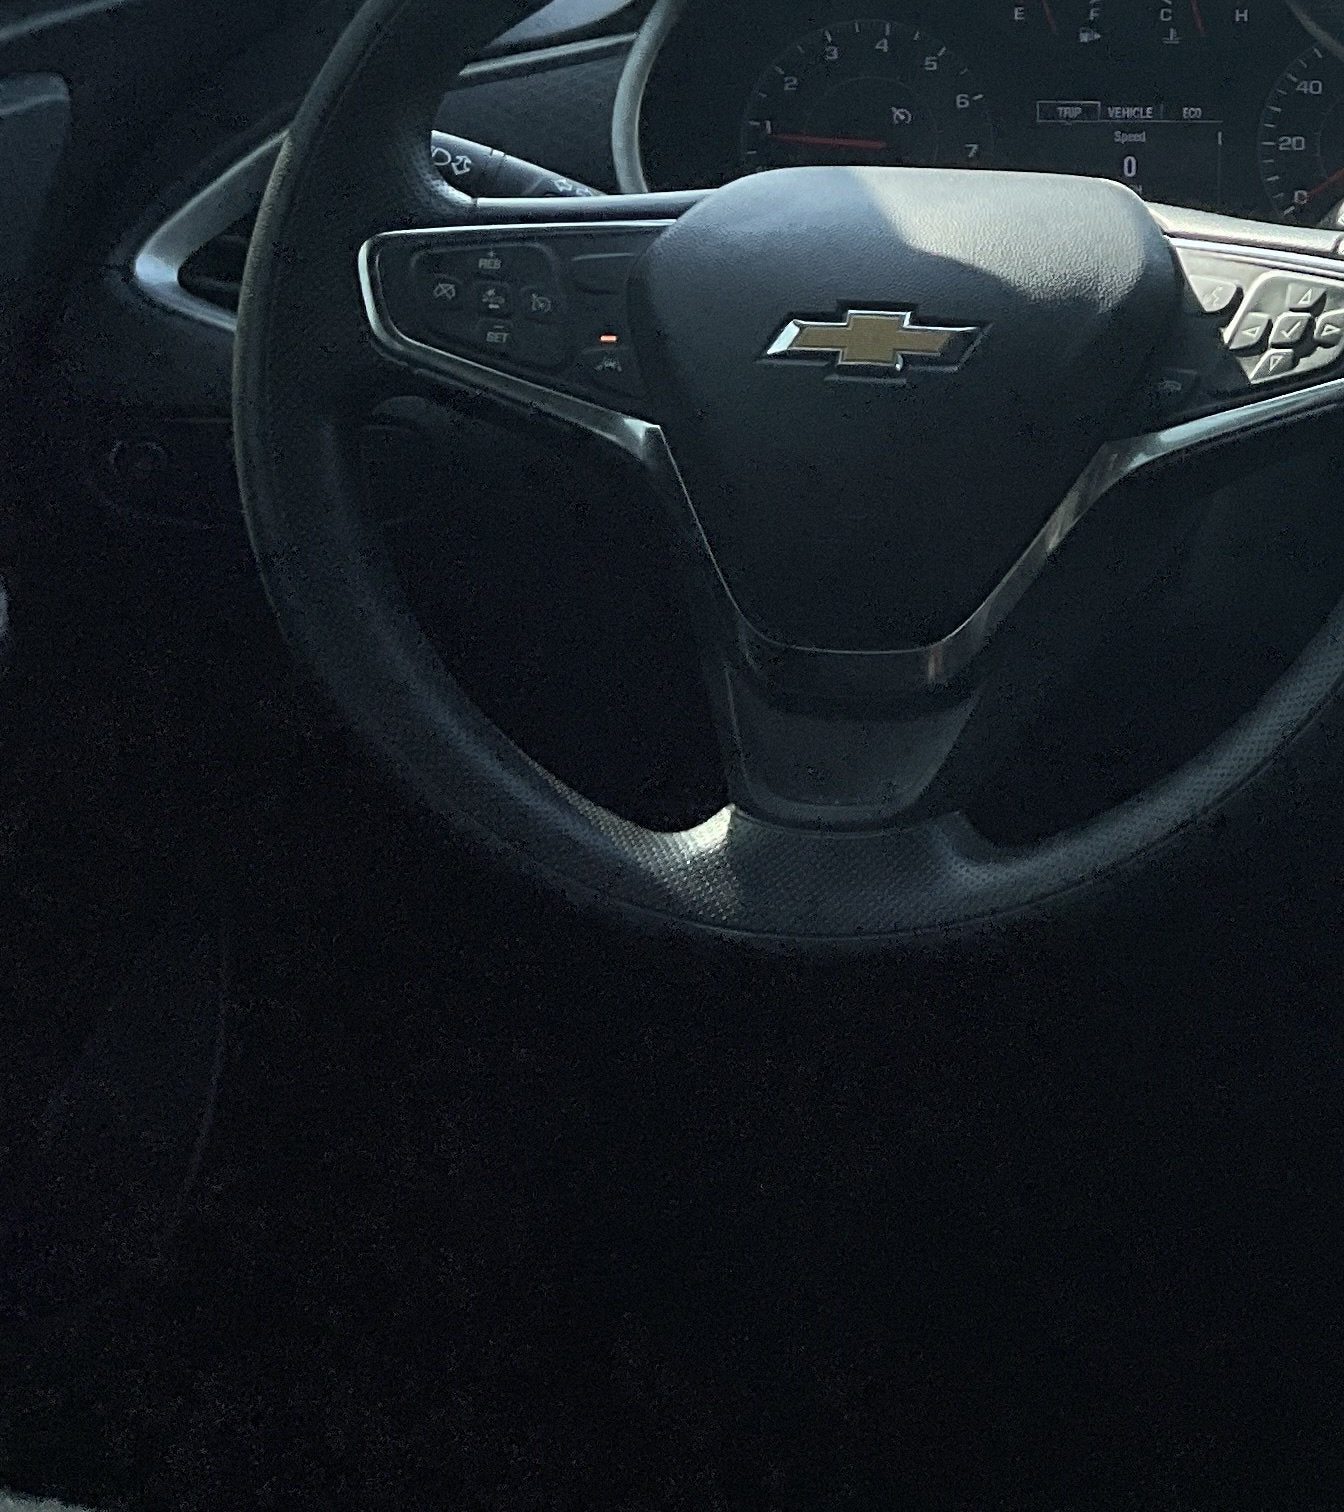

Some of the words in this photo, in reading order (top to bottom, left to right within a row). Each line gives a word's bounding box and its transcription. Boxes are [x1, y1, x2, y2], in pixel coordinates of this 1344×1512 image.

[1013, 6, 1025, 21] E
[1089, 7, 1101, 21] F
[1159, 8, 1173, 22] C
[1234, 8, 1249, 22] H
[874, 37, 889, 53] 4
[824, 45, 839, 61] 3
[924, 56, 939, 72] 5
[783, 76, 799, 92] 2
[1295, 80, 1323, 95] 40
[955, 93, 971, 109] 6
[1107, 106, 1154, 119] VEHICLE
[1113, 130, 1147, 145] Speed
[1278, 136, 1306, 151] 20
[964, 143, 980, 159] 7
[1122, 155, 1137, 178] 0
